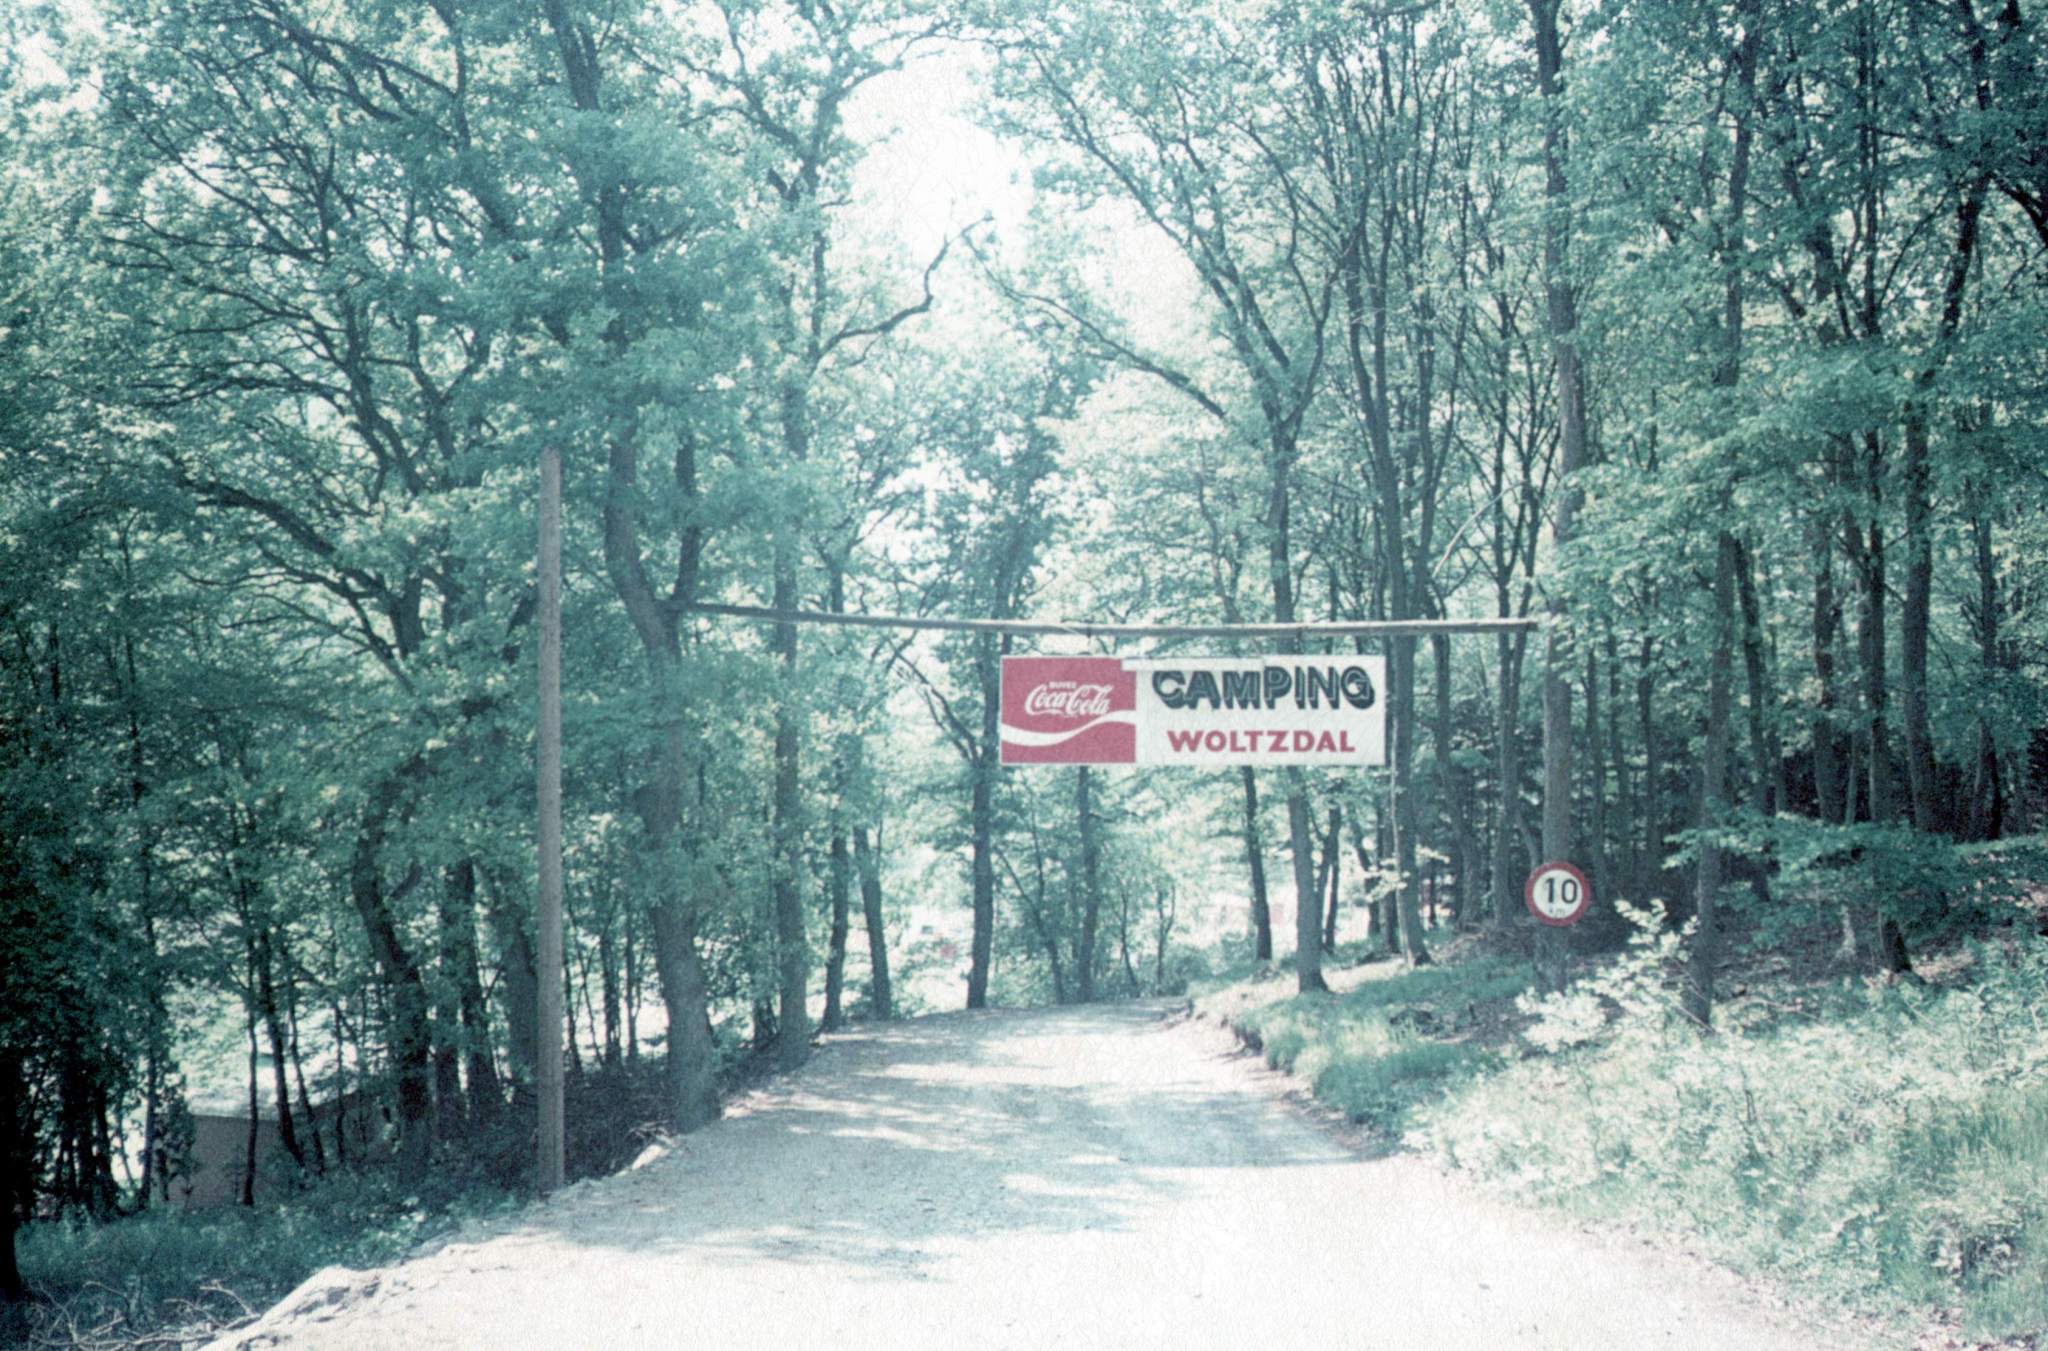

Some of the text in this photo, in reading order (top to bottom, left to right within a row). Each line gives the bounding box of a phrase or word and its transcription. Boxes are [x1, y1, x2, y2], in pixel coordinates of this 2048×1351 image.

[1024, 684, 1114, 718] Coca-Cola
[1152, 666, 1375, 709] CAMPING
[1167, 730, 1355, 753] WOLTZDAL
[1545, 878, 1577, 903] 10
